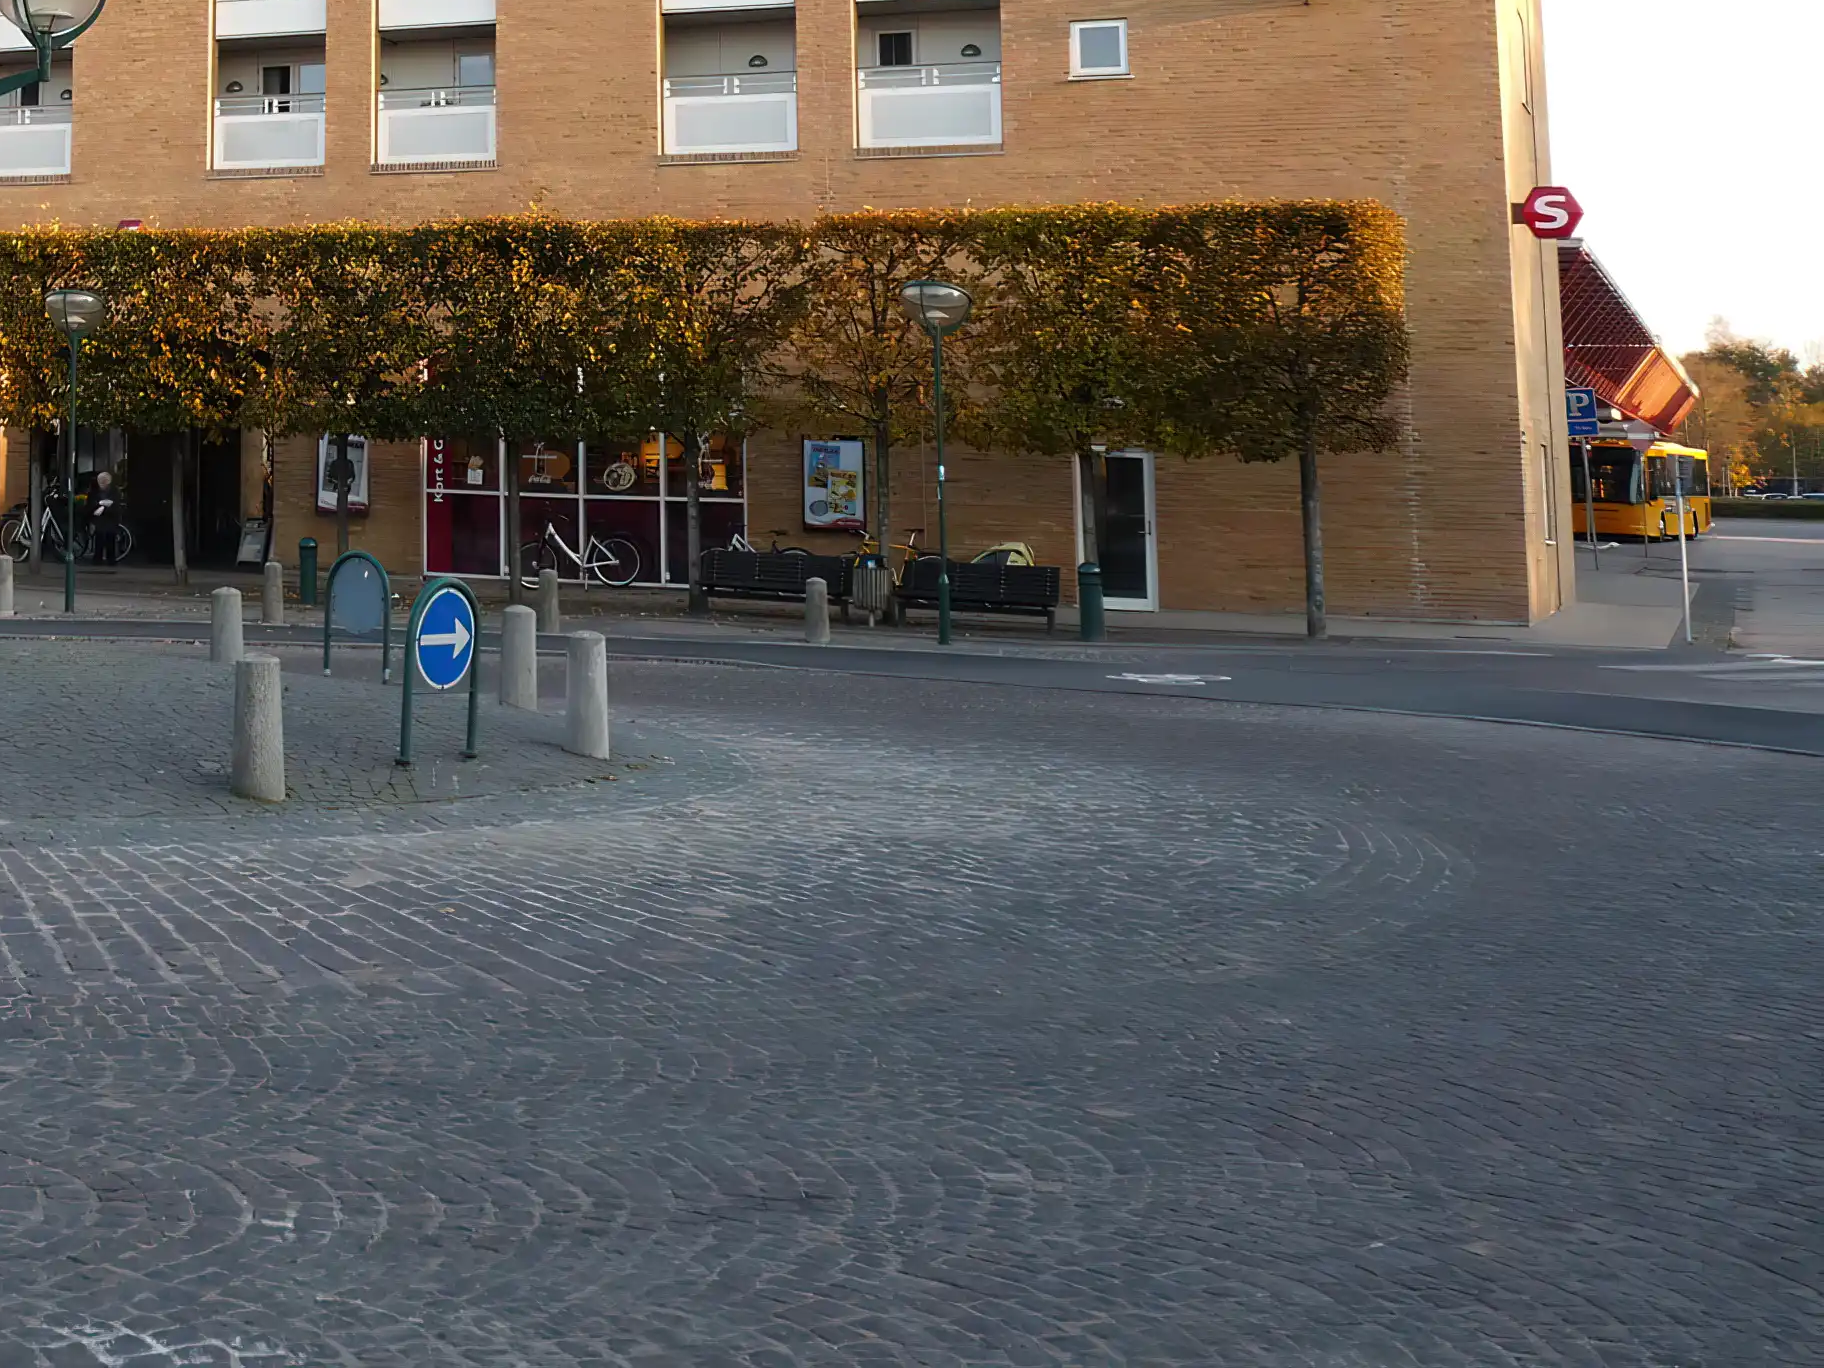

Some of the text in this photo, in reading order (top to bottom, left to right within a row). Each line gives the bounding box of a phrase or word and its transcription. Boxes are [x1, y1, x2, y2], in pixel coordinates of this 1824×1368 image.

[1534, 195, 1568, 229] S
[1566, 392, 1589, 416] P
[433, 467, 444, 503] Kort
